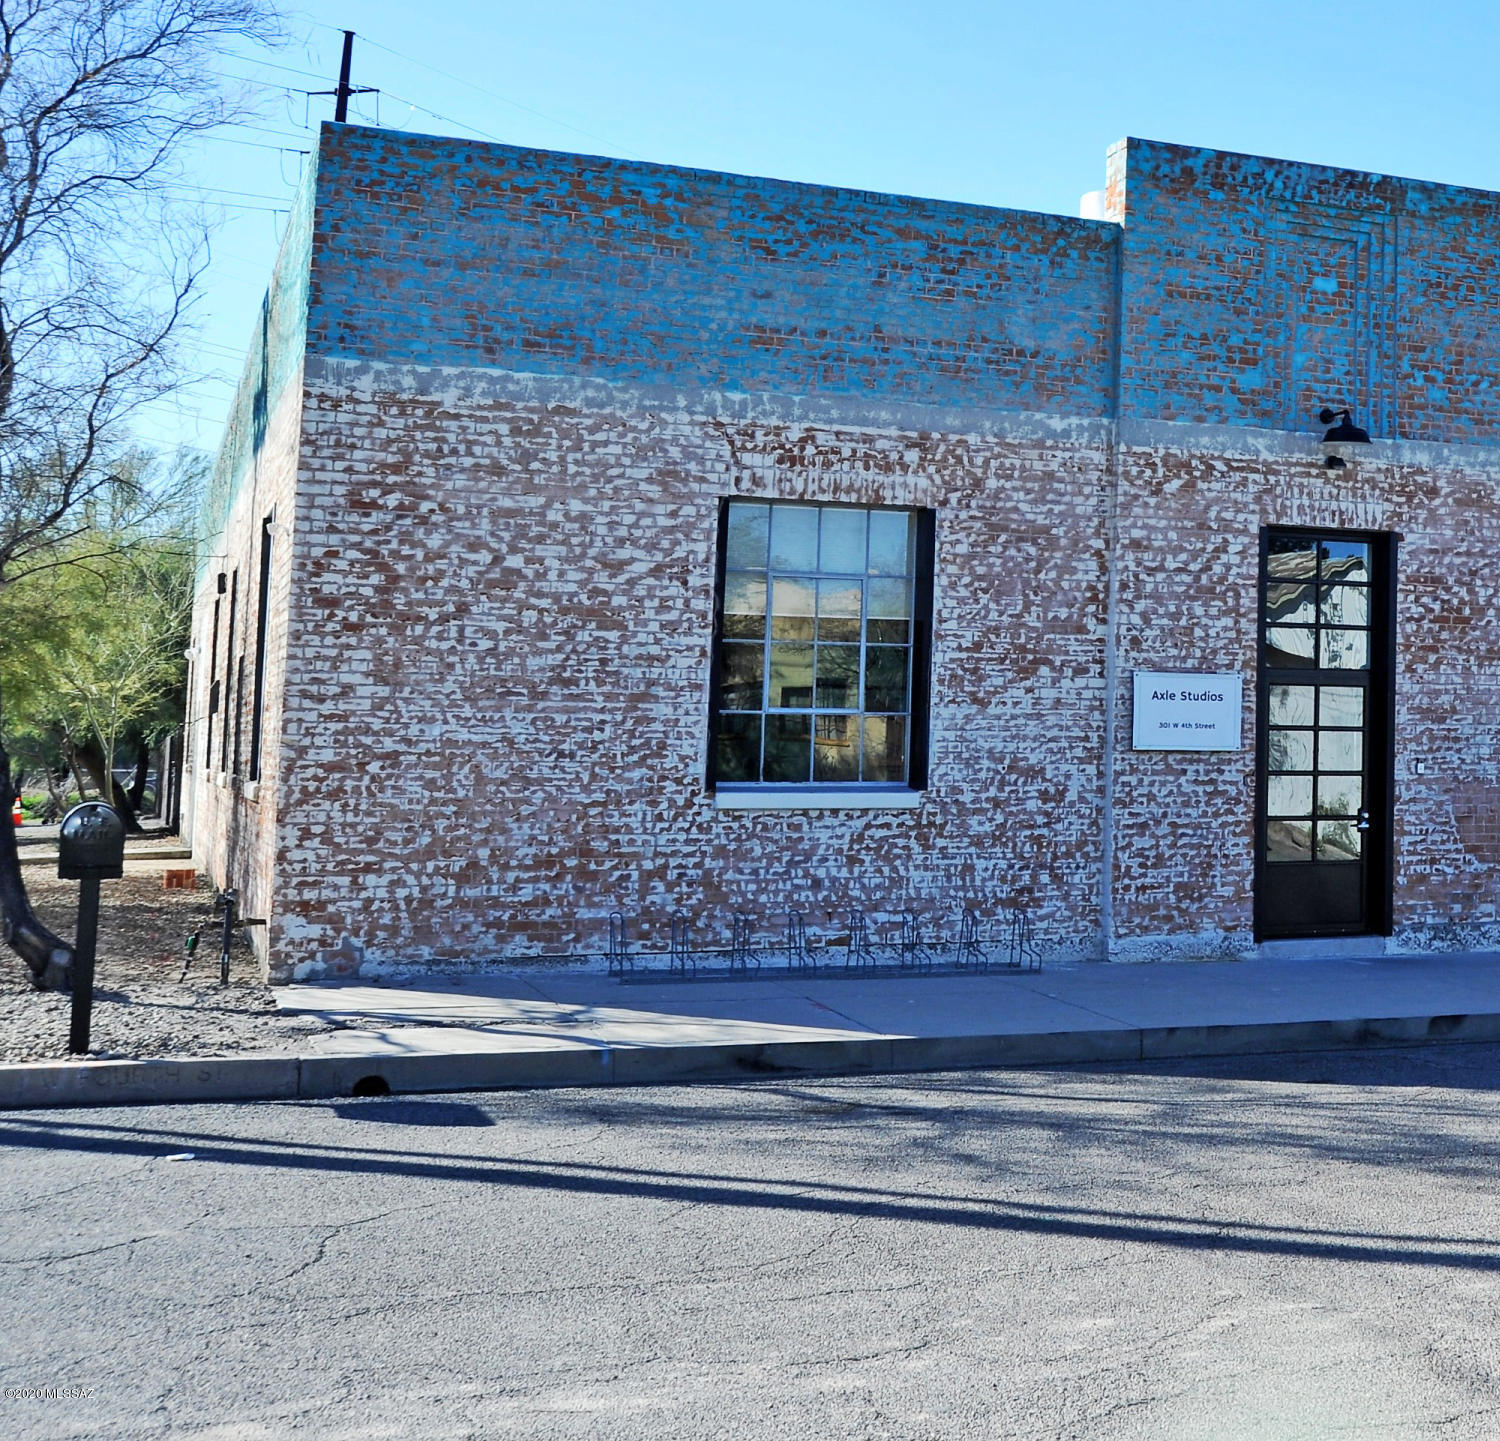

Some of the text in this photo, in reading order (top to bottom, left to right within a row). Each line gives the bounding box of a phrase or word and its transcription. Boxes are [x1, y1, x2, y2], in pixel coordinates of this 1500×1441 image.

[1151, 690, 1224, 702] Axle Studios
[1194, 722, 1216, 730] Street
